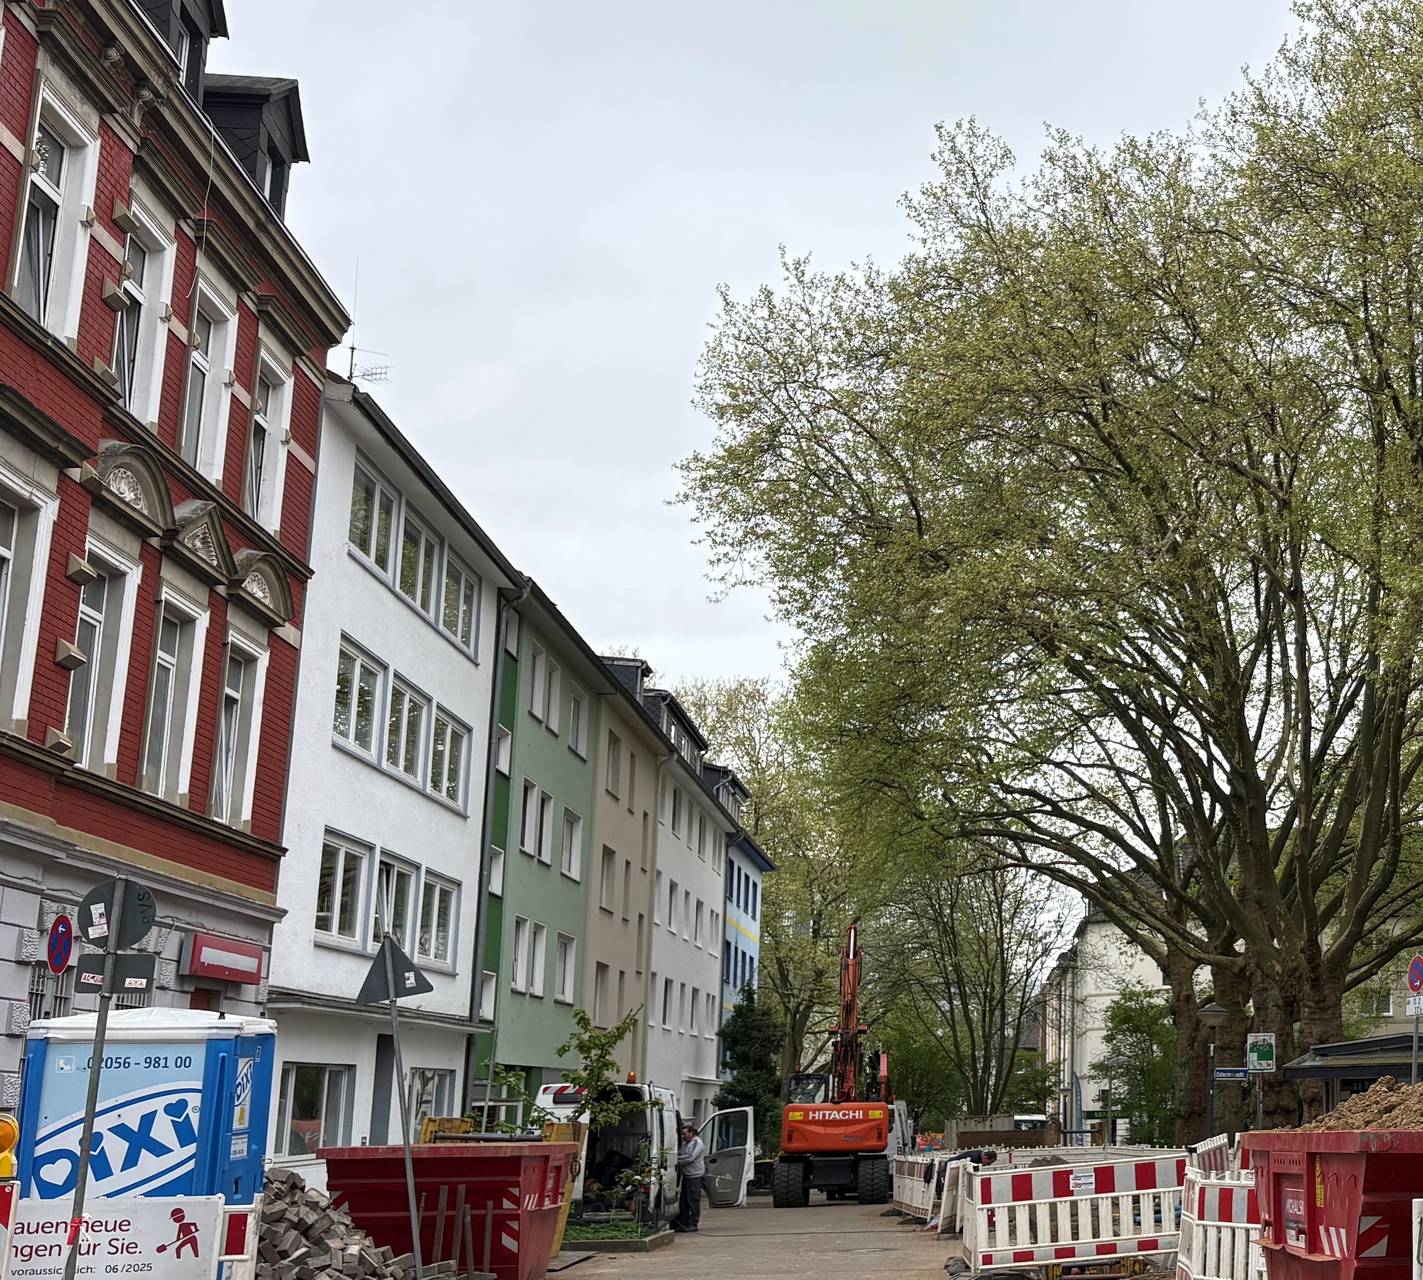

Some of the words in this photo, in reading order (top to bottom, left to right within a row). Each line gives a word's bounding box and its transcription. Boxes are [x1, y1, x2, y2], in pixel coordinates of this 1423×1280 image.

[144, 1056, 169, 1069] 981
[174, 1056, 192, 1069] 00
[808, 1110, 863, 1120] HITACHI
[14, 1219, 68, 1235] auen
[12, 1243, 62, 1262] ngen
[77, 1238, 101, 1256] ür
[107, 1237, 143, 1256] Sie.
